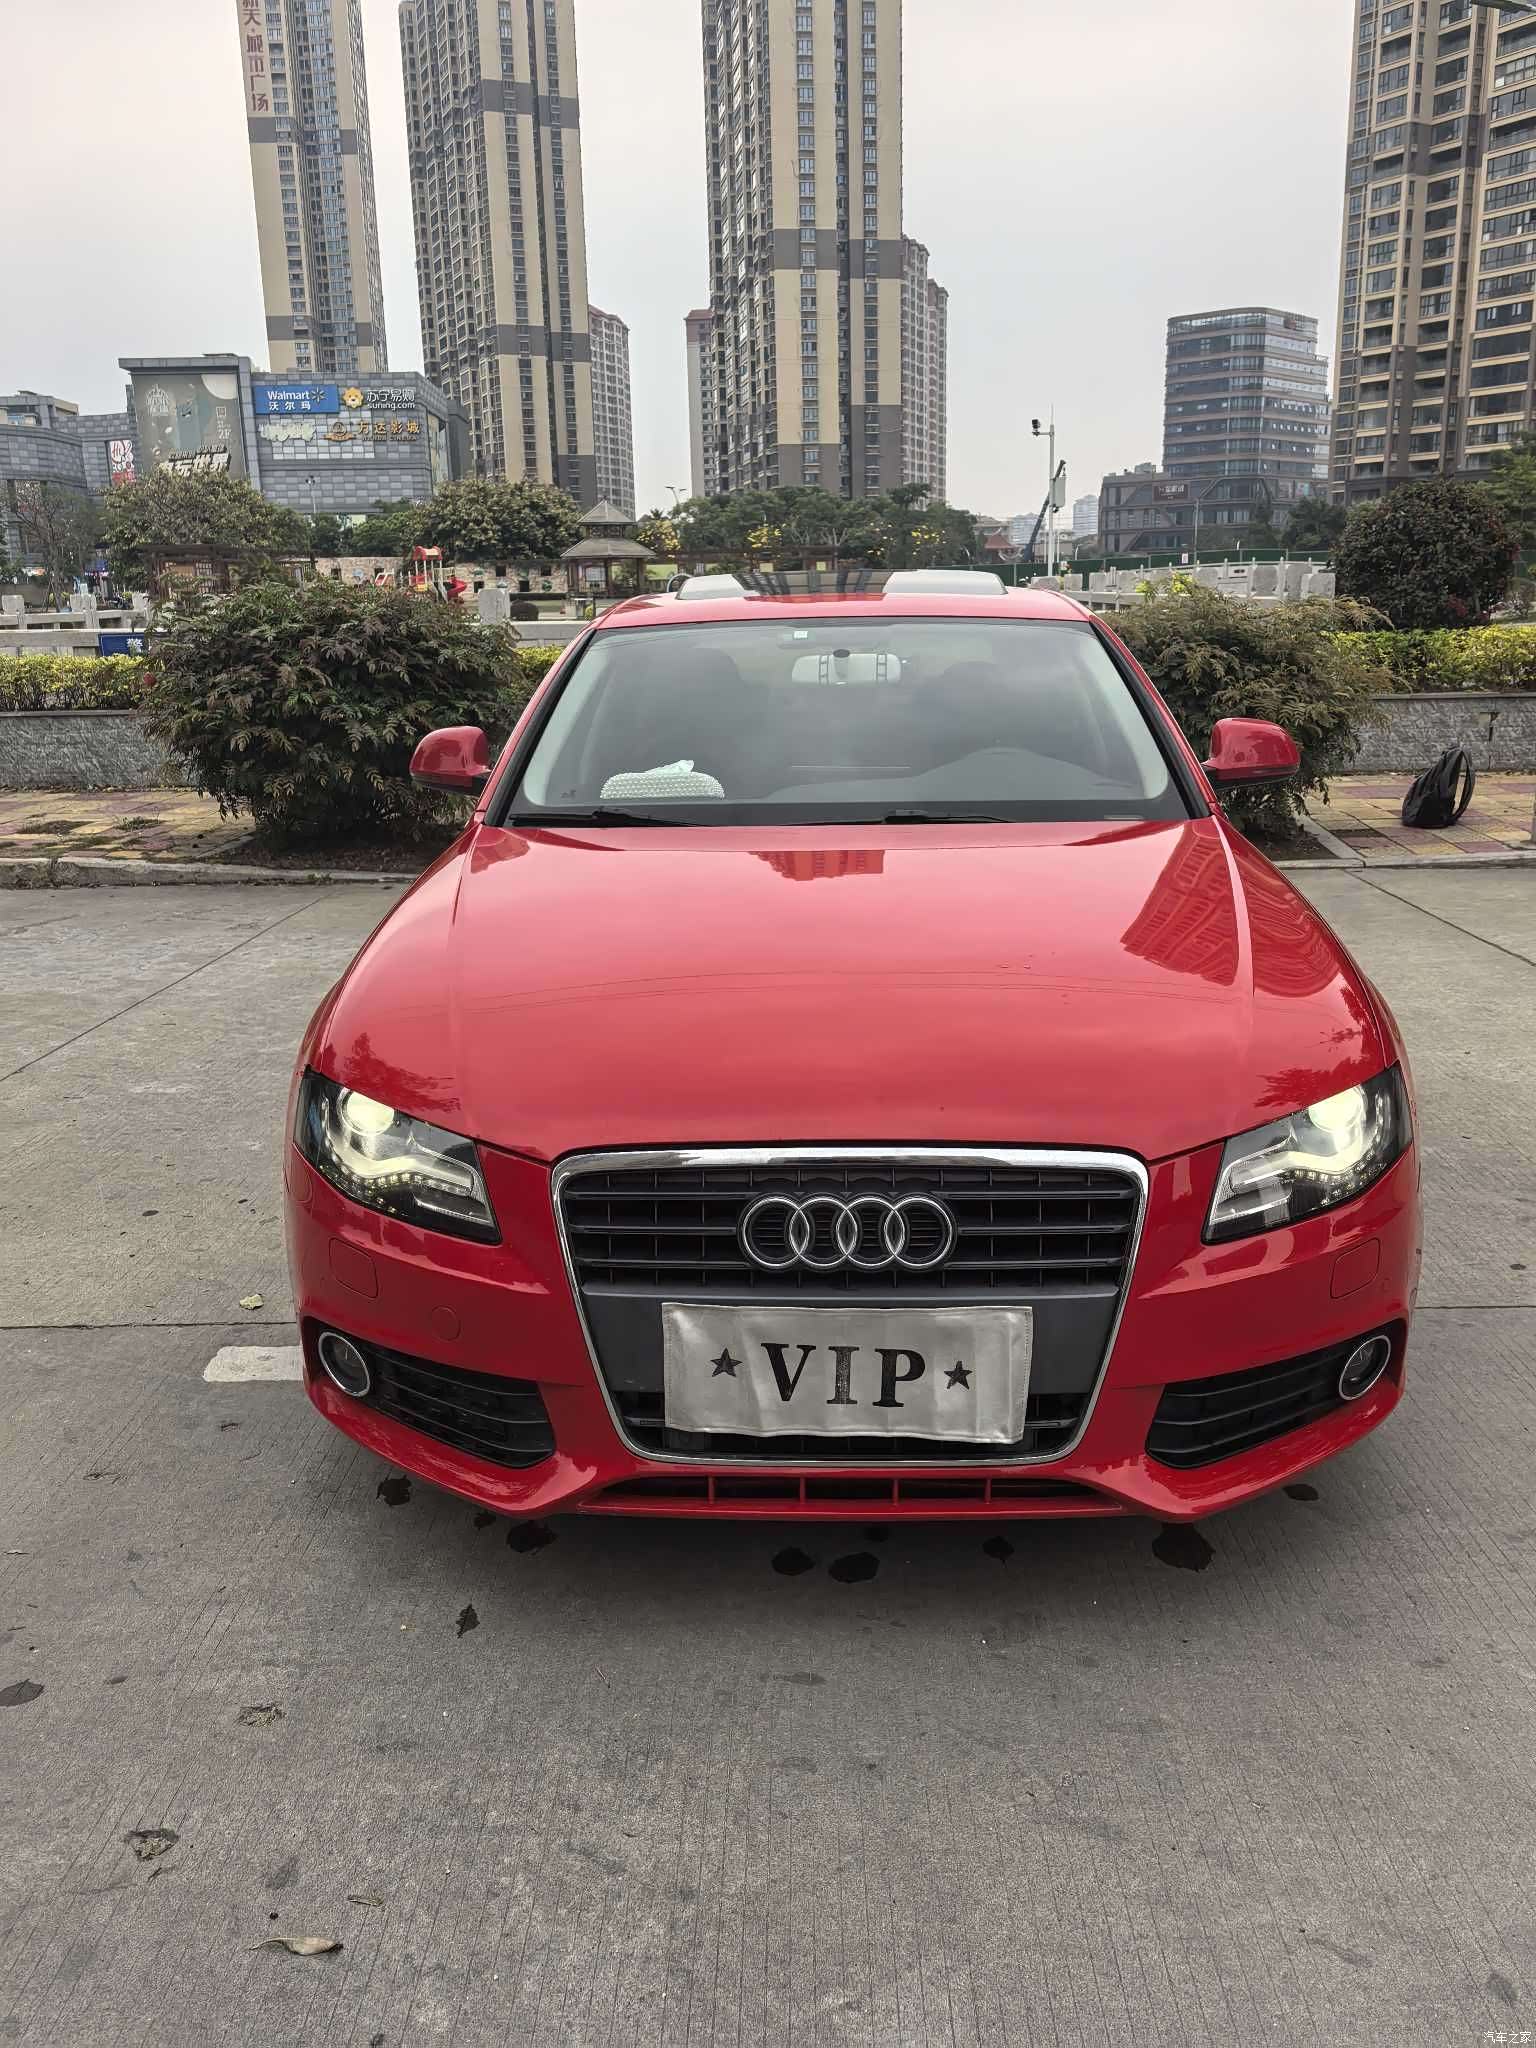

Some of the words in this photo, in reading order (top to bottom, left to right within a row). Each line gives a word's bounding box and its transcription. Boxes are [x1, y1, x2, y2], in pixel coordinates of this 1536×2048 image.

[267, 390, 310, 400] Walmart
[366, 389, 415, 402] 苏宁易购
[268, 401, 311, 411] 沃尔玛
[367, 401, 415, 411] suning.com
[358, 420, 420, 434] 万达影城
[760, 1342, 926, 1408] VIP
